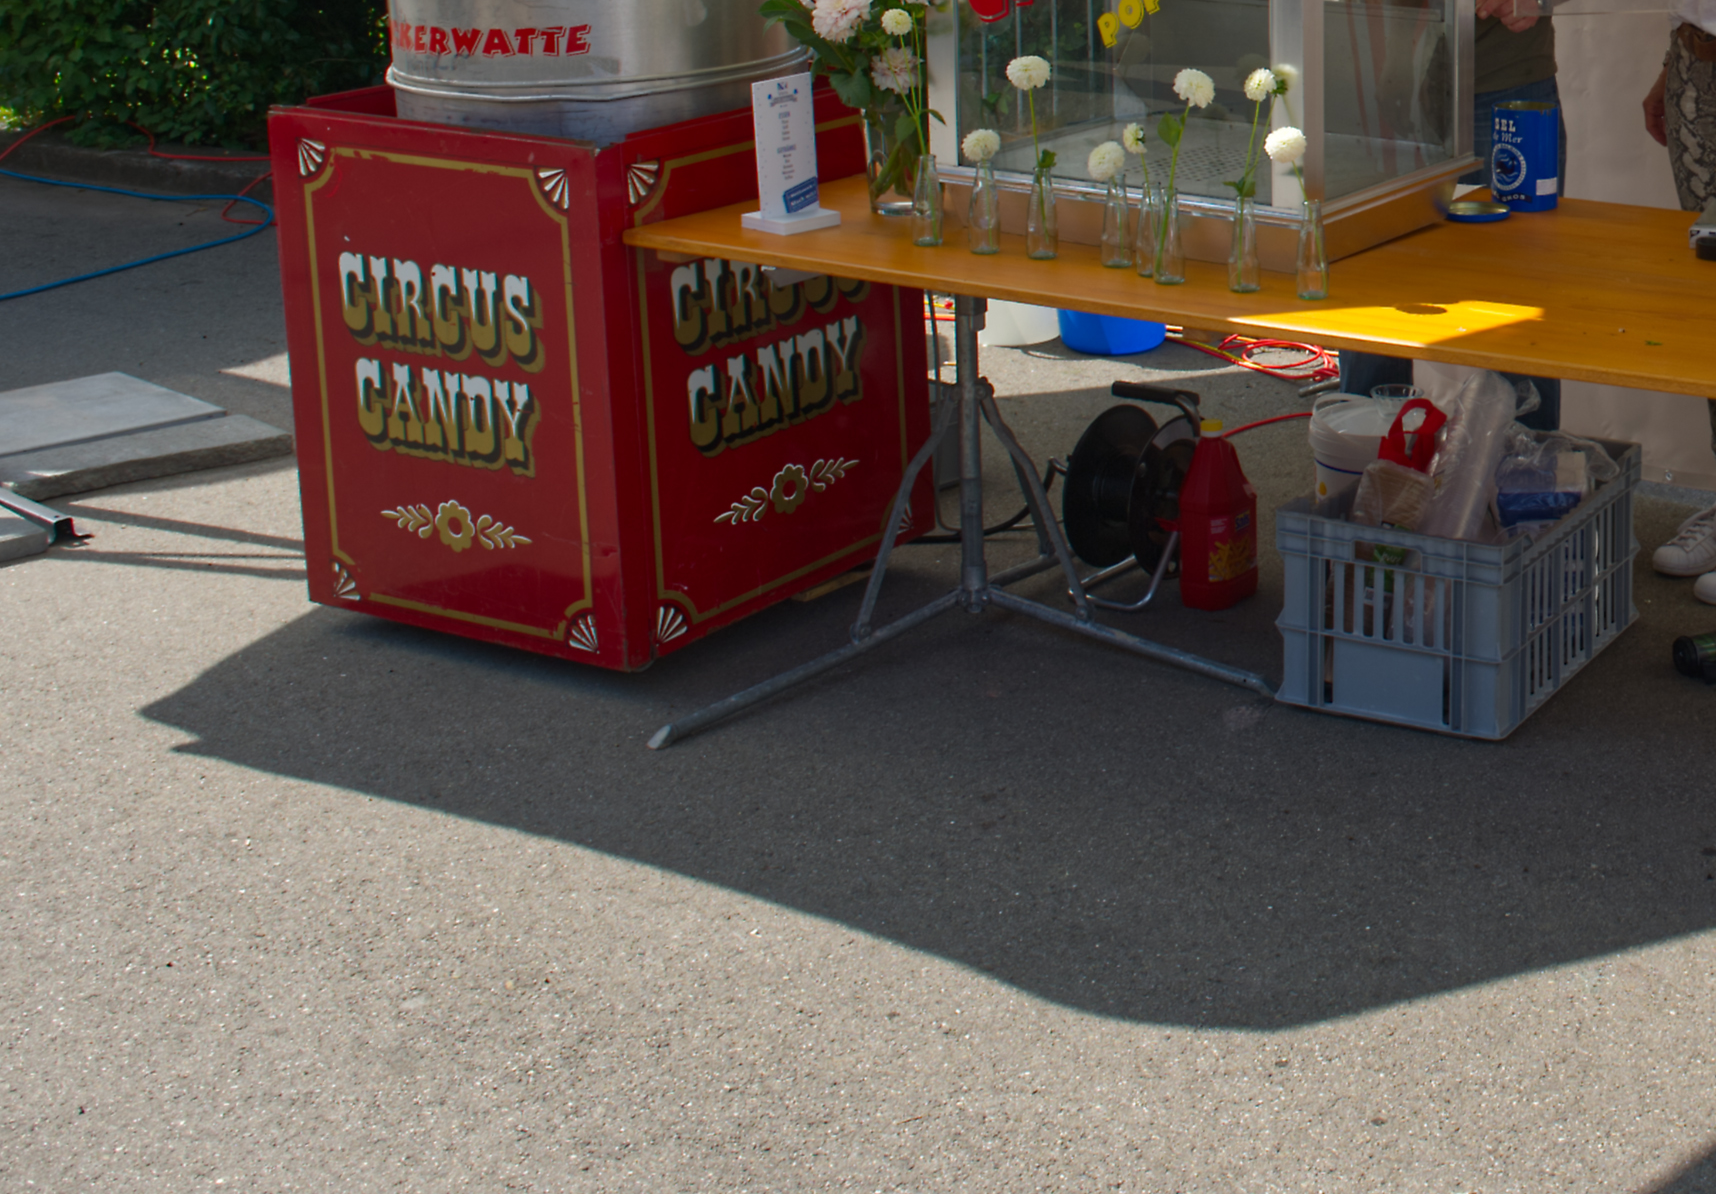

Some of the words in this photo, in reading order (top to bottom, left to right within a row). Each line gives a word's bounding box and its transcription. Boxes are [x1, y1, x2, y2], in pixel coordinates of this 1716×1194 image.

[338, 251, 545, 374] CIRCUS
[670, 258, 870, 357] CIR
[355, 357, 541, 478] CANDY
[687, 315, 864, 458] CANDY
